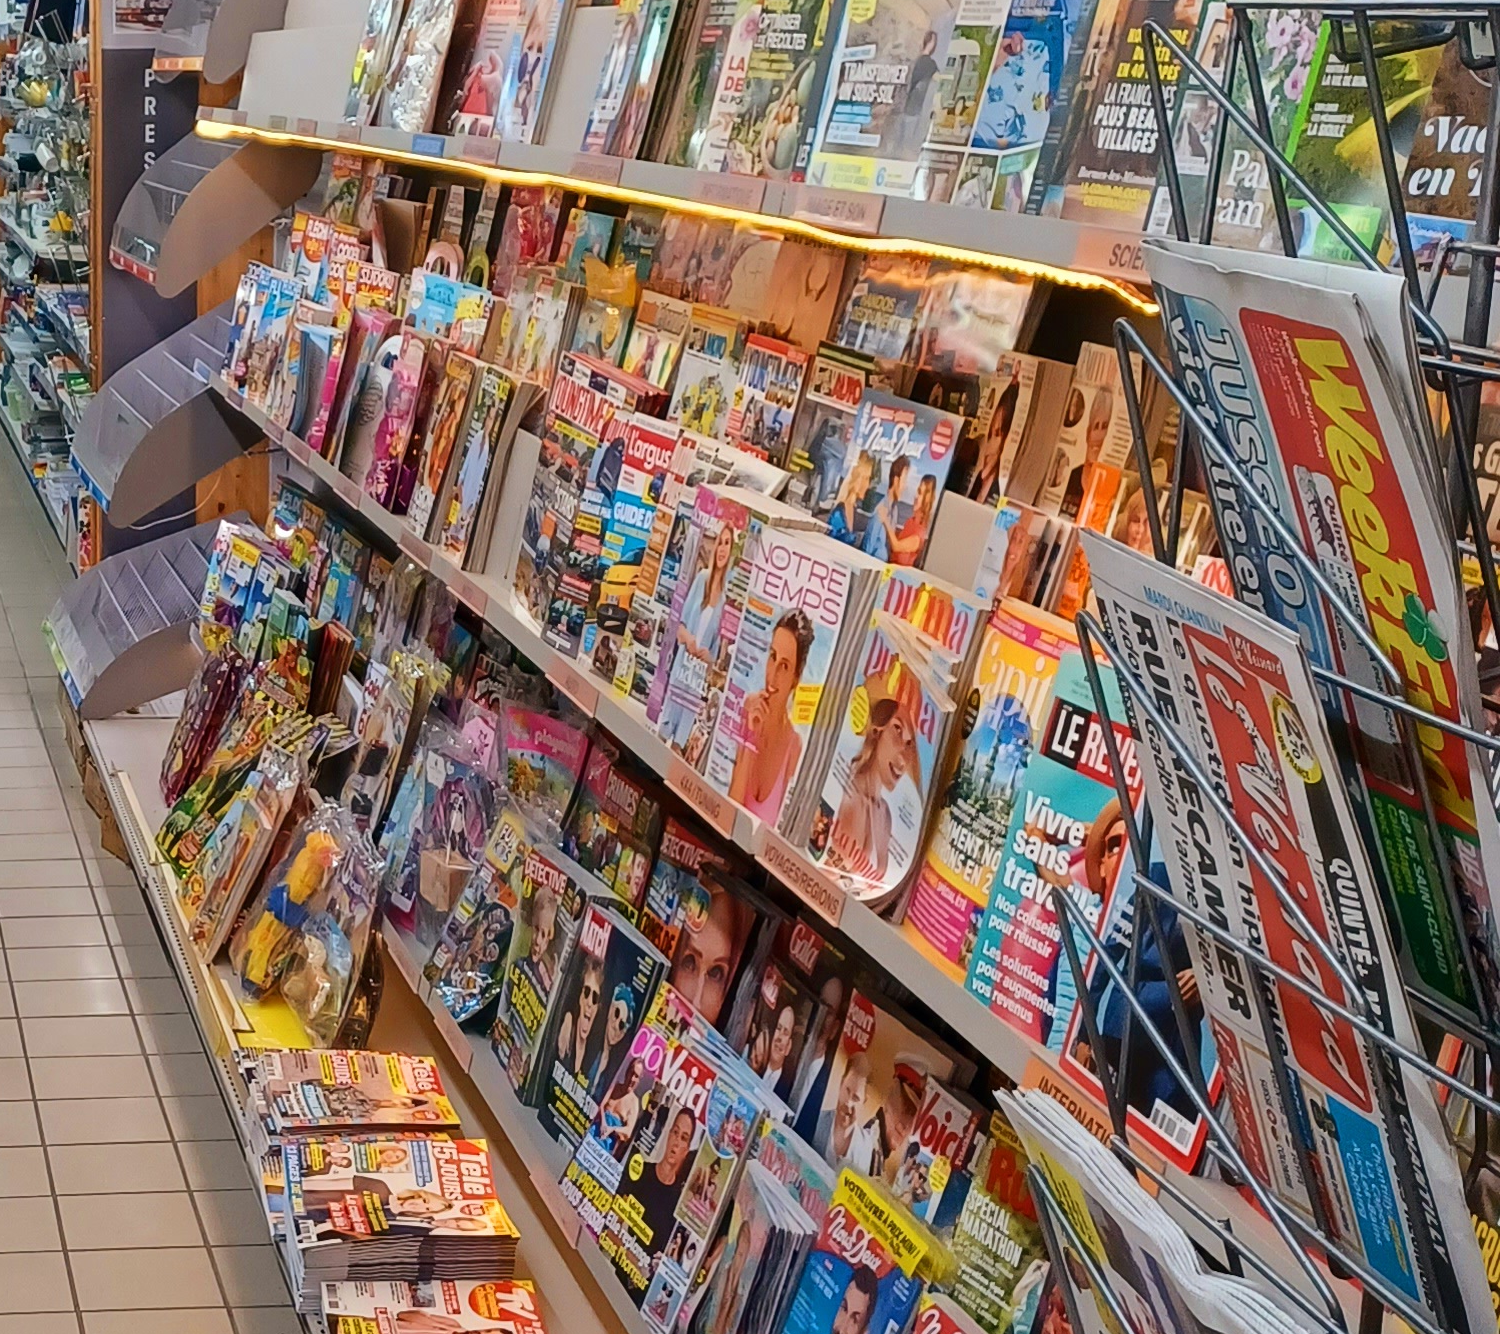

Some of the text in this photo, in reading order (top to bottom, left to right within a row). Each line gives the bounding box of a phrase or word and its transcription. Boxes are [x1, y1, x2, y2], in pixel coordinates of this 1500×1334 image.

[1093, 103, 1123, 127] PLUS
[1097, 128, 1159, 154] VILLAGES
[758, 534, 847, 599] NOTRE
[748, 562, 841, 626] TEMPS
[1130, 610, 1183, 727] RUE
[1051, 707, 1086, 760] LE
[1025, 790, 1085, 847] Vivre
[1012, 828, 1071, 876] sans
[989, 914, 1054, 959] pour réussir
[994, 893, 1062, 943] Nos conseils
[976, 959, 1003, 989] pour
[982, 939, 1050, 992] Les solutions
[972, 977, 1034, 1025] vos revenus
[661, 1046, 715, 1120] Voici
[439, 1163, 464, 1201] JOURS
[459, 1151, 494, 1196] Télé
[969, 1192, 1011, 1235] SPÉCIAL
[829, 1206, 883, 1275] Nous Deux
[963, 1217, 1023, 1268] MARATHON
